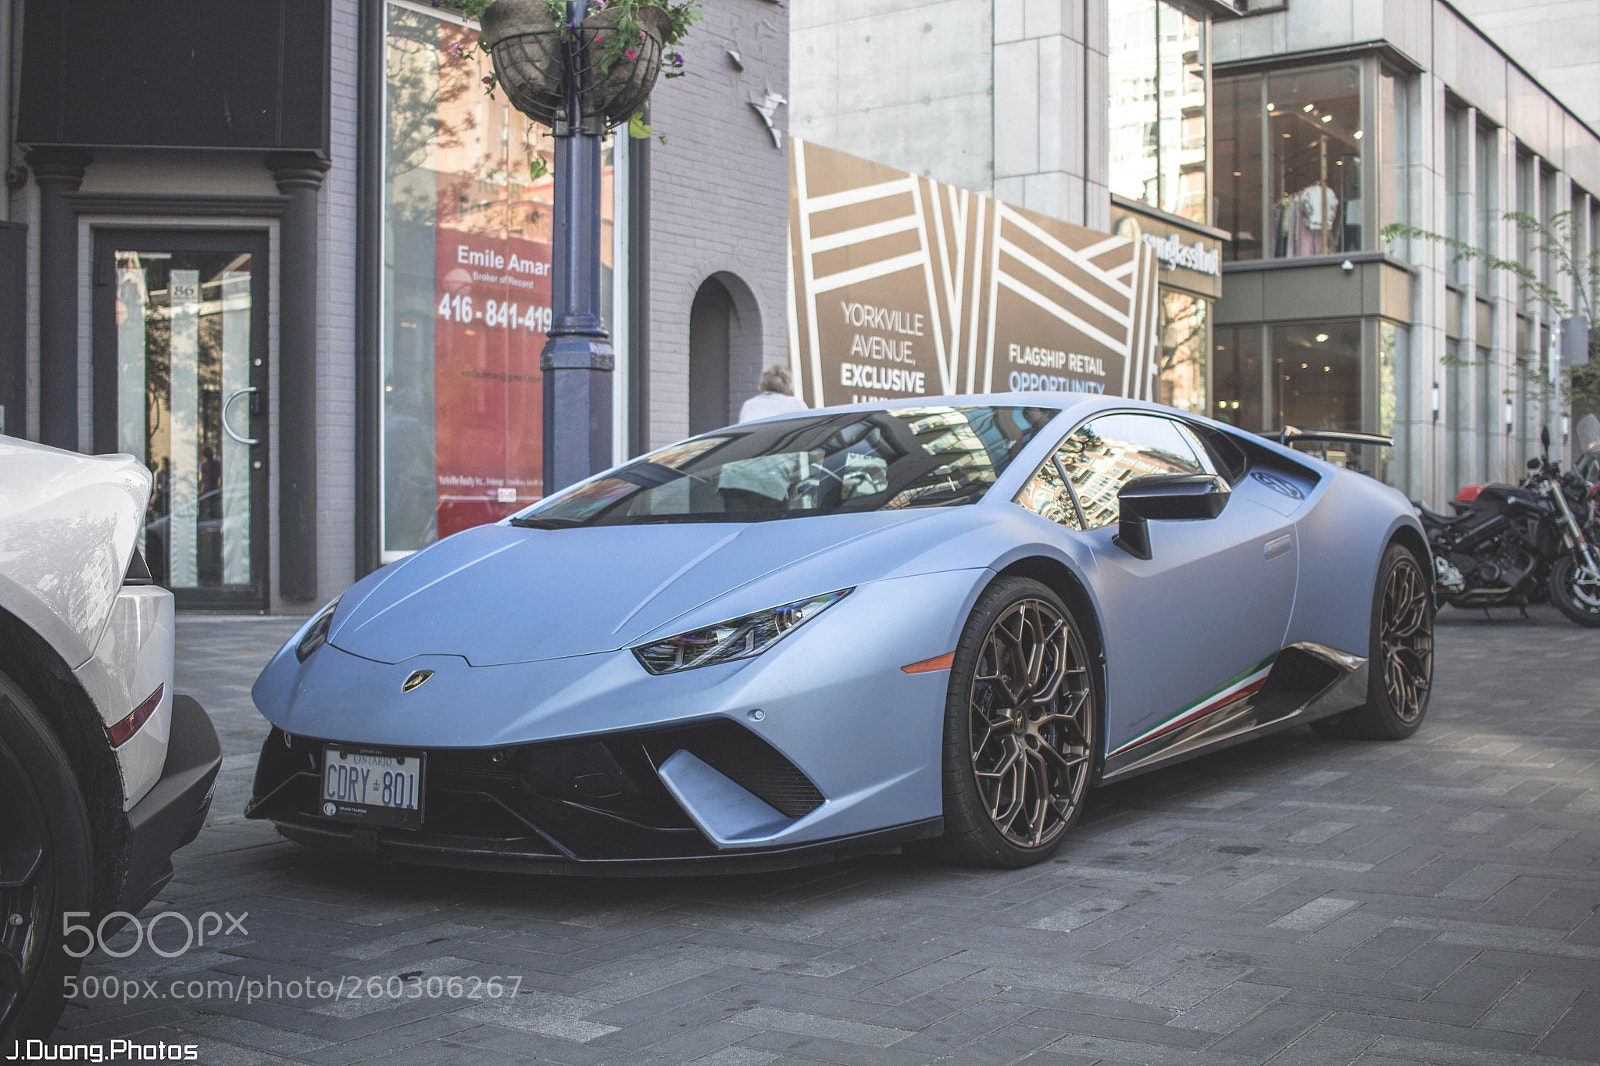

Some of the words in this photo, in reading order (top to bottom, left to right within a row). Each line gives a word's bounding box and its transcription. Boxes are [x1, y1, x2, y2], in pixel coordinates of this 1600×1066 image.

[457, 244, 505, 269] Emile
[508, 253, 551, 277] Amar
[174, 284, 195, 297] 86
[472, 271, 498, 283] Broker
[499, 275, 509, 285] of
[508, 276, 534, 289] Record
[438, 293, 473, 323] 416
[840, 300, 924, 336] YORKVILLE
[850, 333, 917, 367] AVENUE,
[1008, 343, 1066, 367] FLAGSHIP
[1067, 353, 1106, 377] RETAIL
[840, 362, 925, 394] EXCLUSIVE
[1008, 370, 1106, 396] OPPORTUNITY
[353, 753, 393, 768] ONTARIO
[326, 763, 371, 804] CDRY
[381, 770, 416, 810] 801
